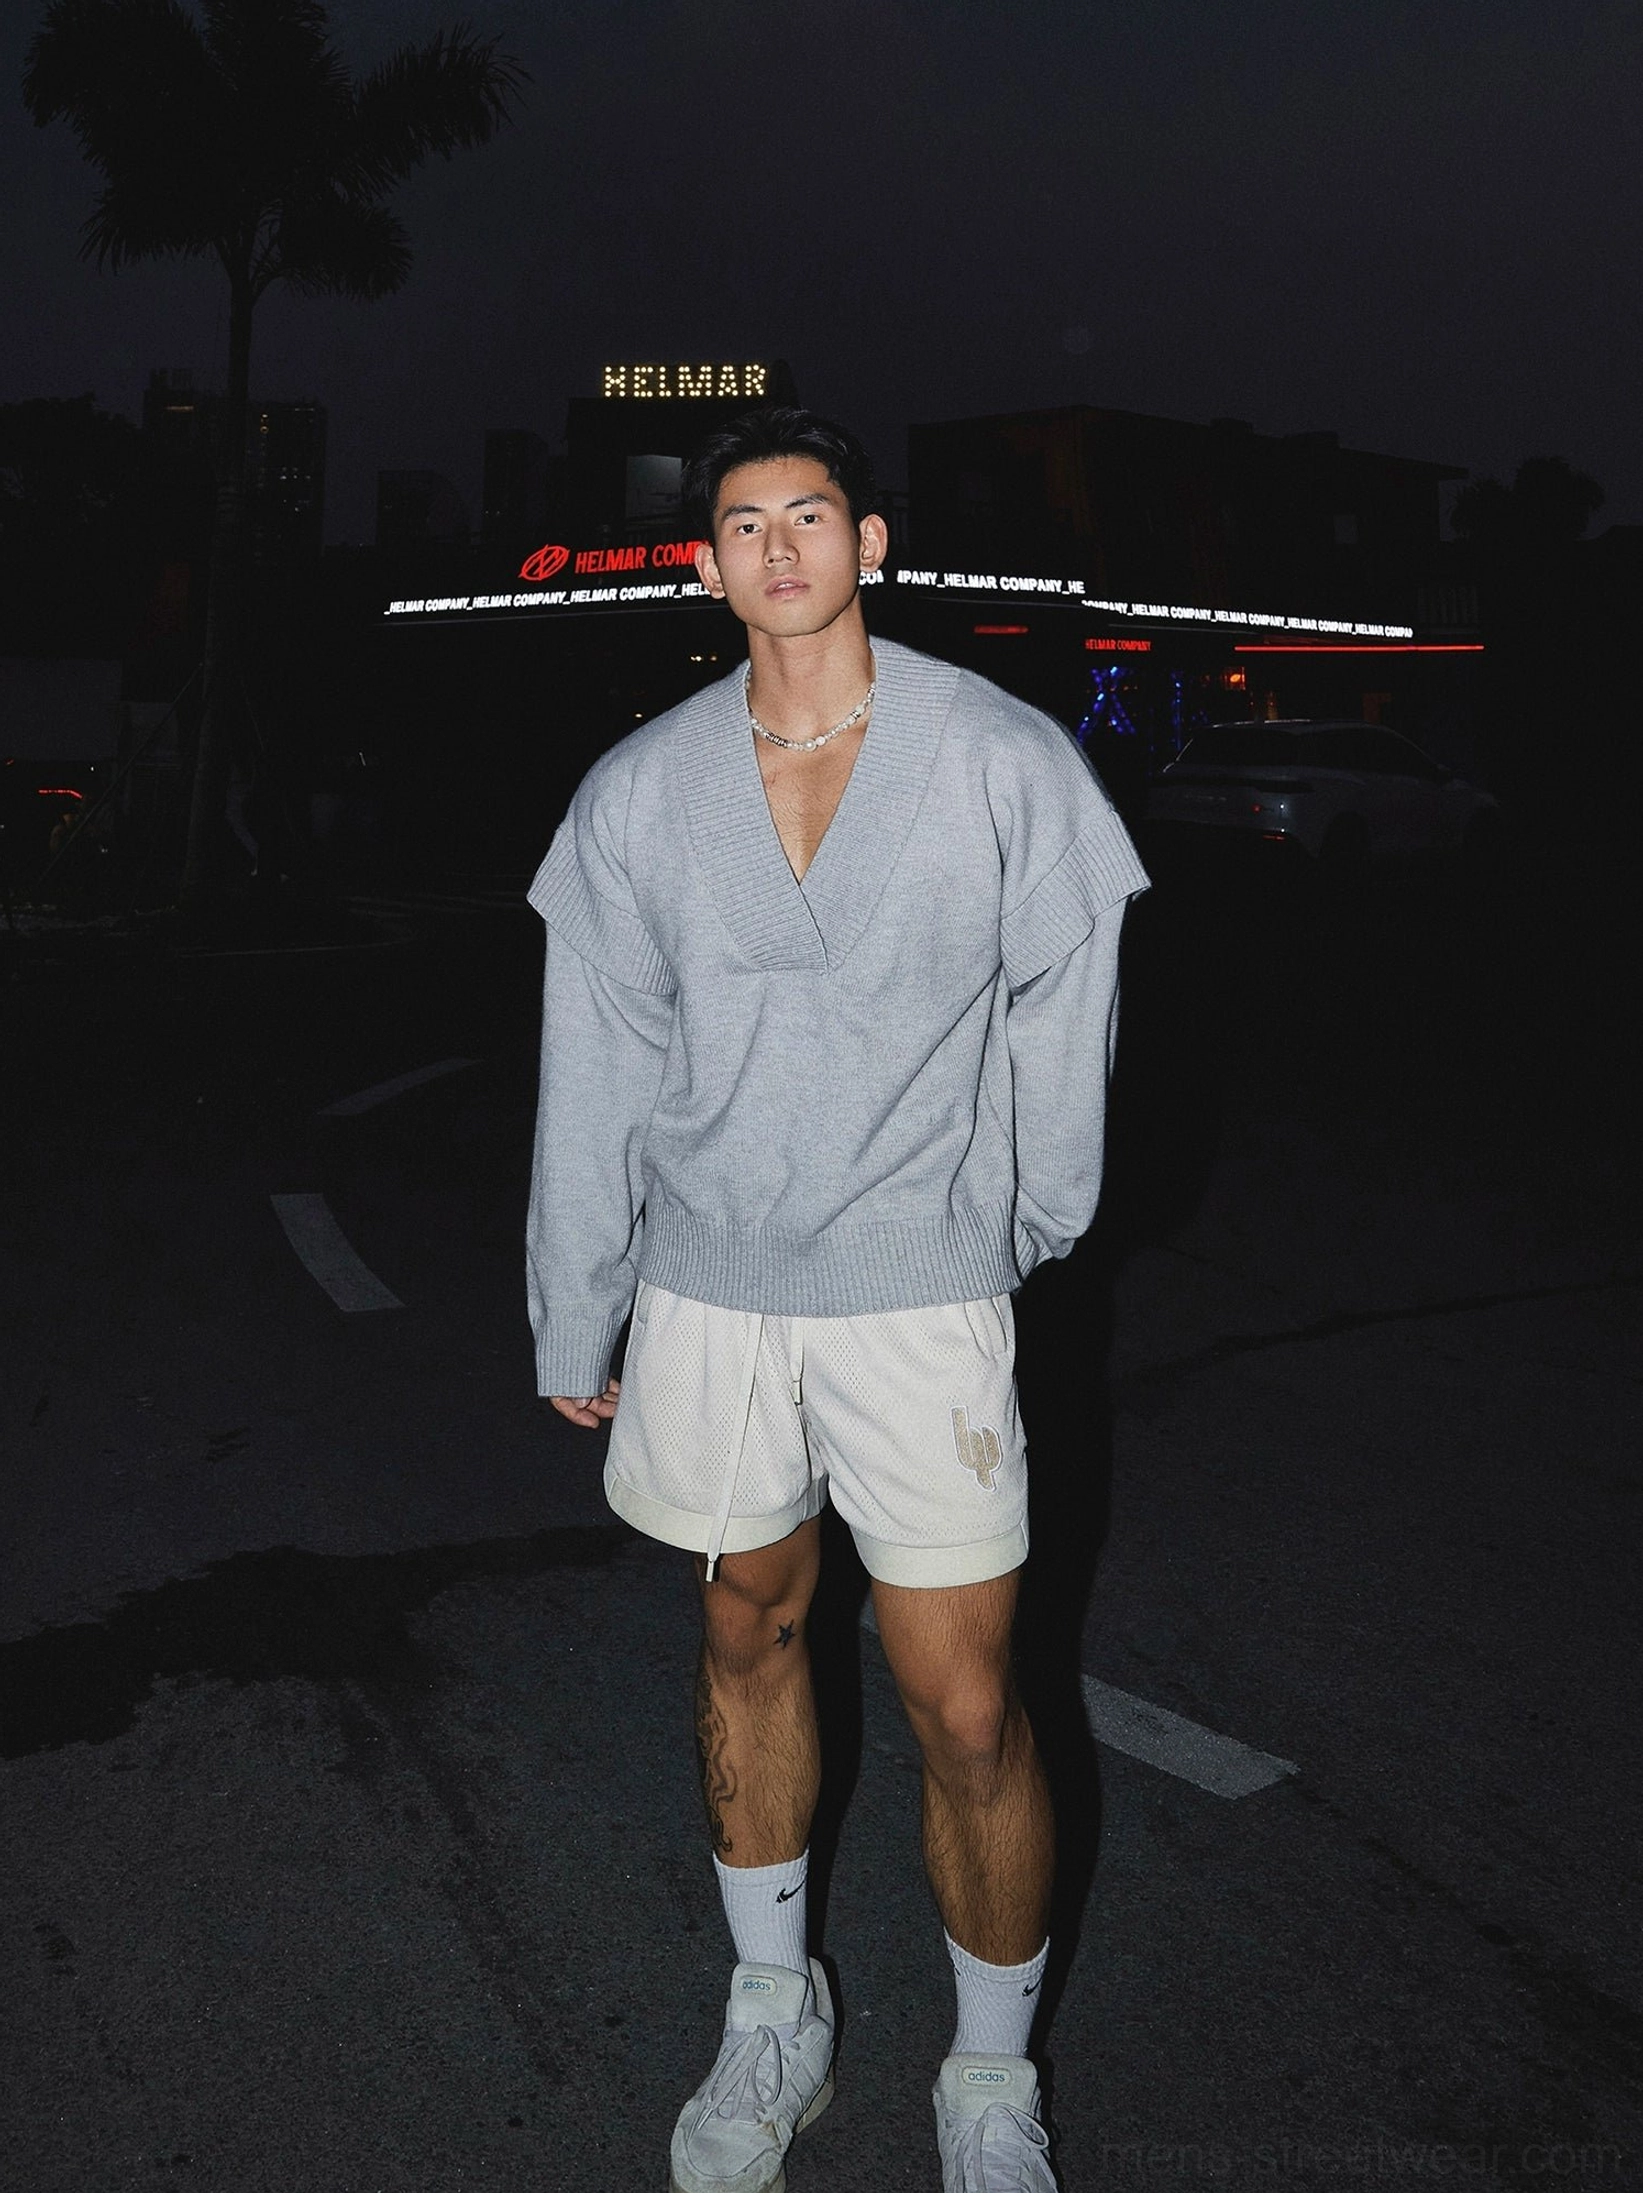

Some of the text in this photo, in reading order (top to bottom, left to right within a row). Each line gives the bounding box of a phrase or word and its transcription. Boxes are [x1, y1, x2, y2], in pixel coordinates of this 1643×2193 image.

[604, 364, 767, 397] HELMAR
[574, 546, 647, 574] HELMAR
[619, 582, 711, 600] COMPANY_HEL
[1085, 639, 1152, 651] HELMAR COMPANY
[742, 1979, 771, 1991] adidas
[968, 2070, 1005, 2082] adidas
